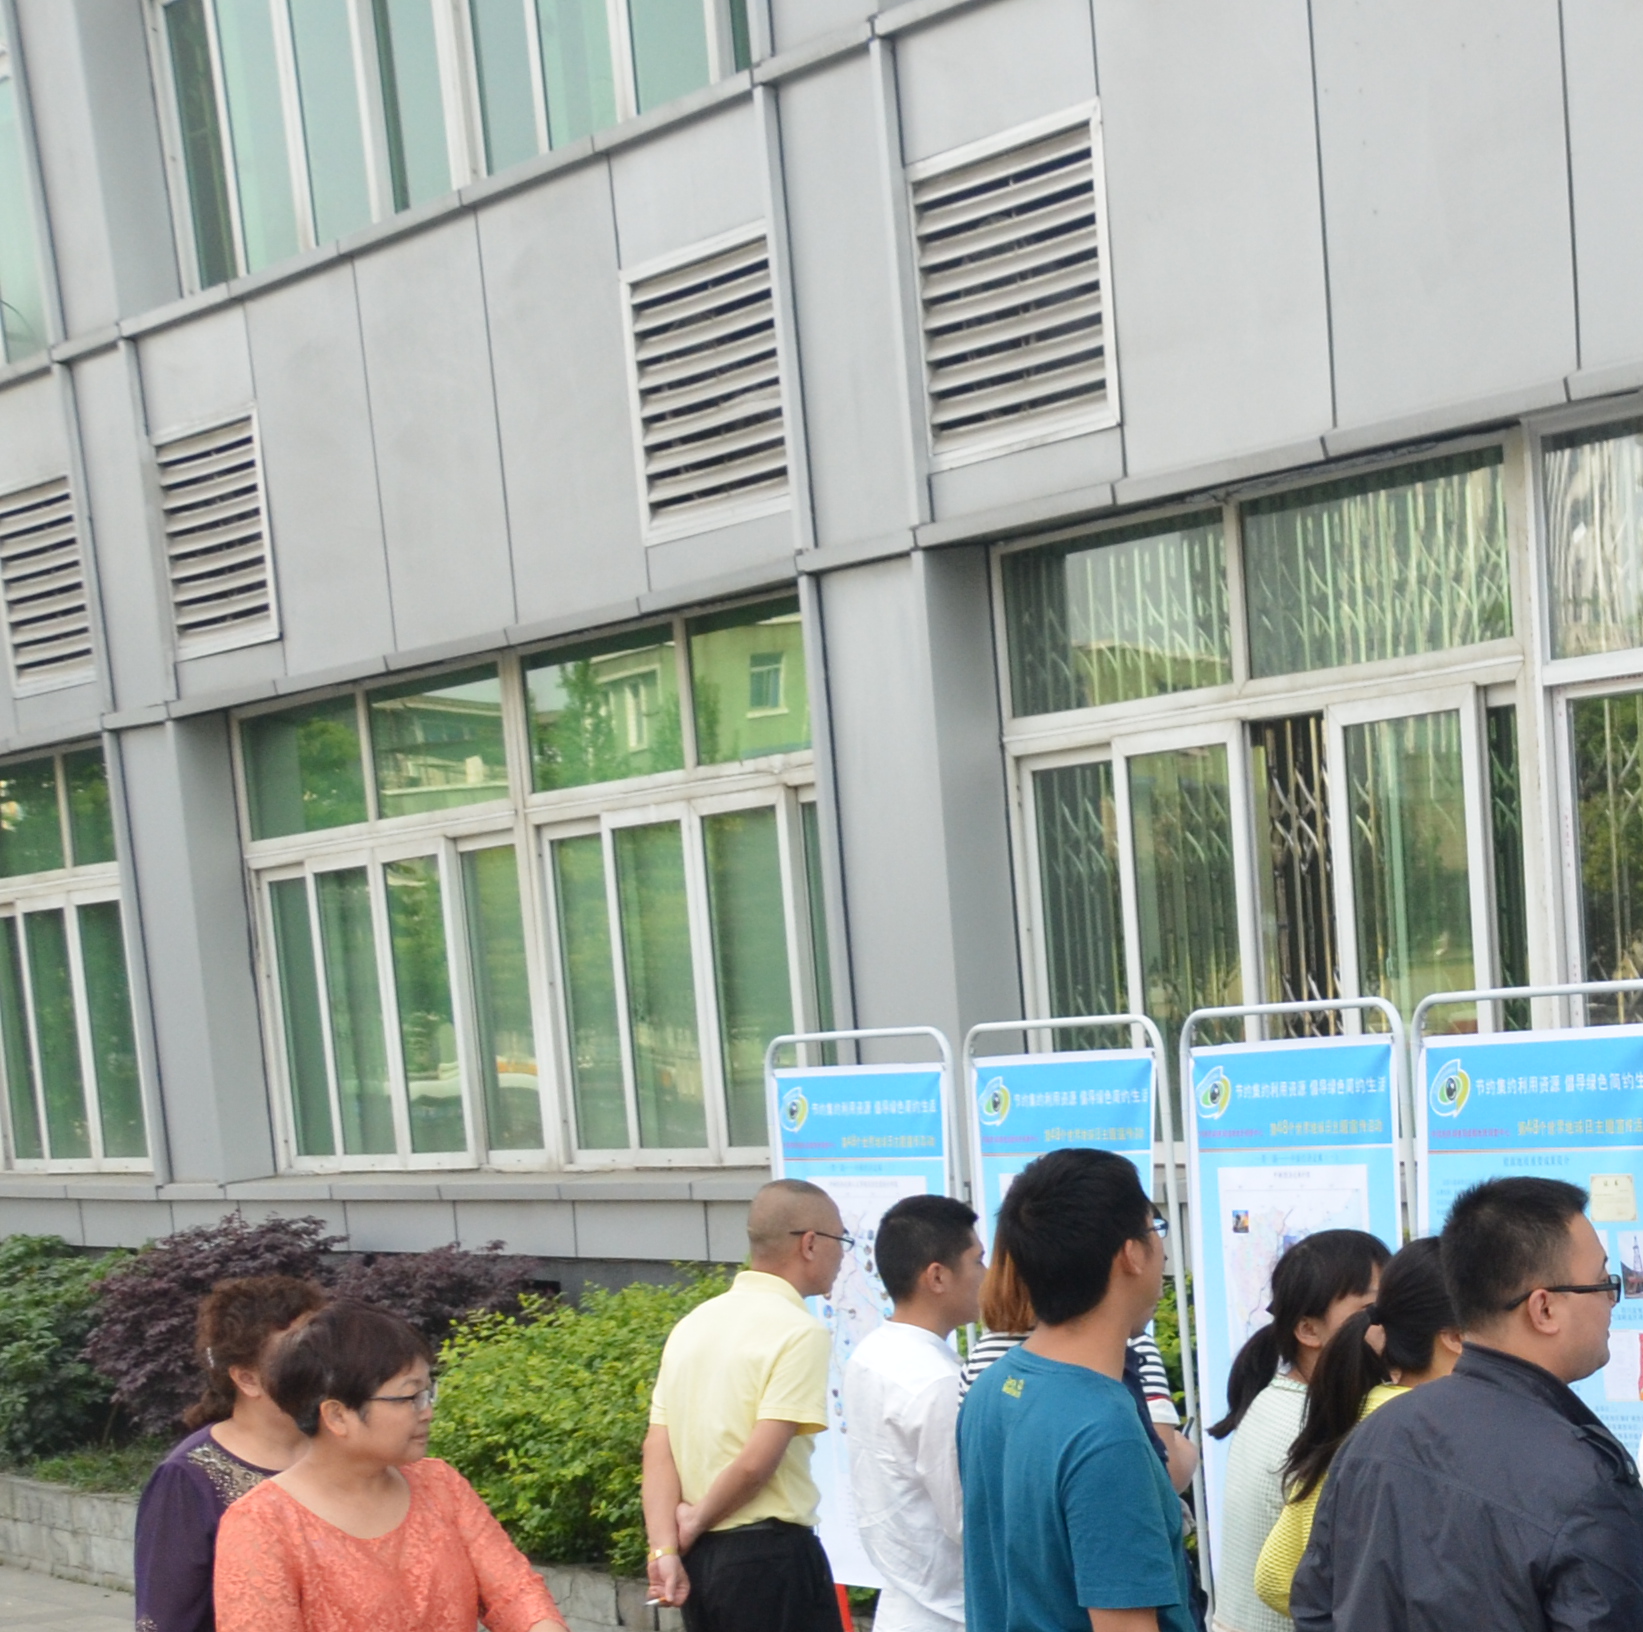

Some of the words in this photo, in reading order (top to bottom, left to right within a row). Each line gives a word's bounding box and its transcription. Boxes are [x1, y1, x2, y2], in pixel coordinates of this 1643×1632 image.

[1475, 1075, 1561, 1096] 节约集约利用资源
